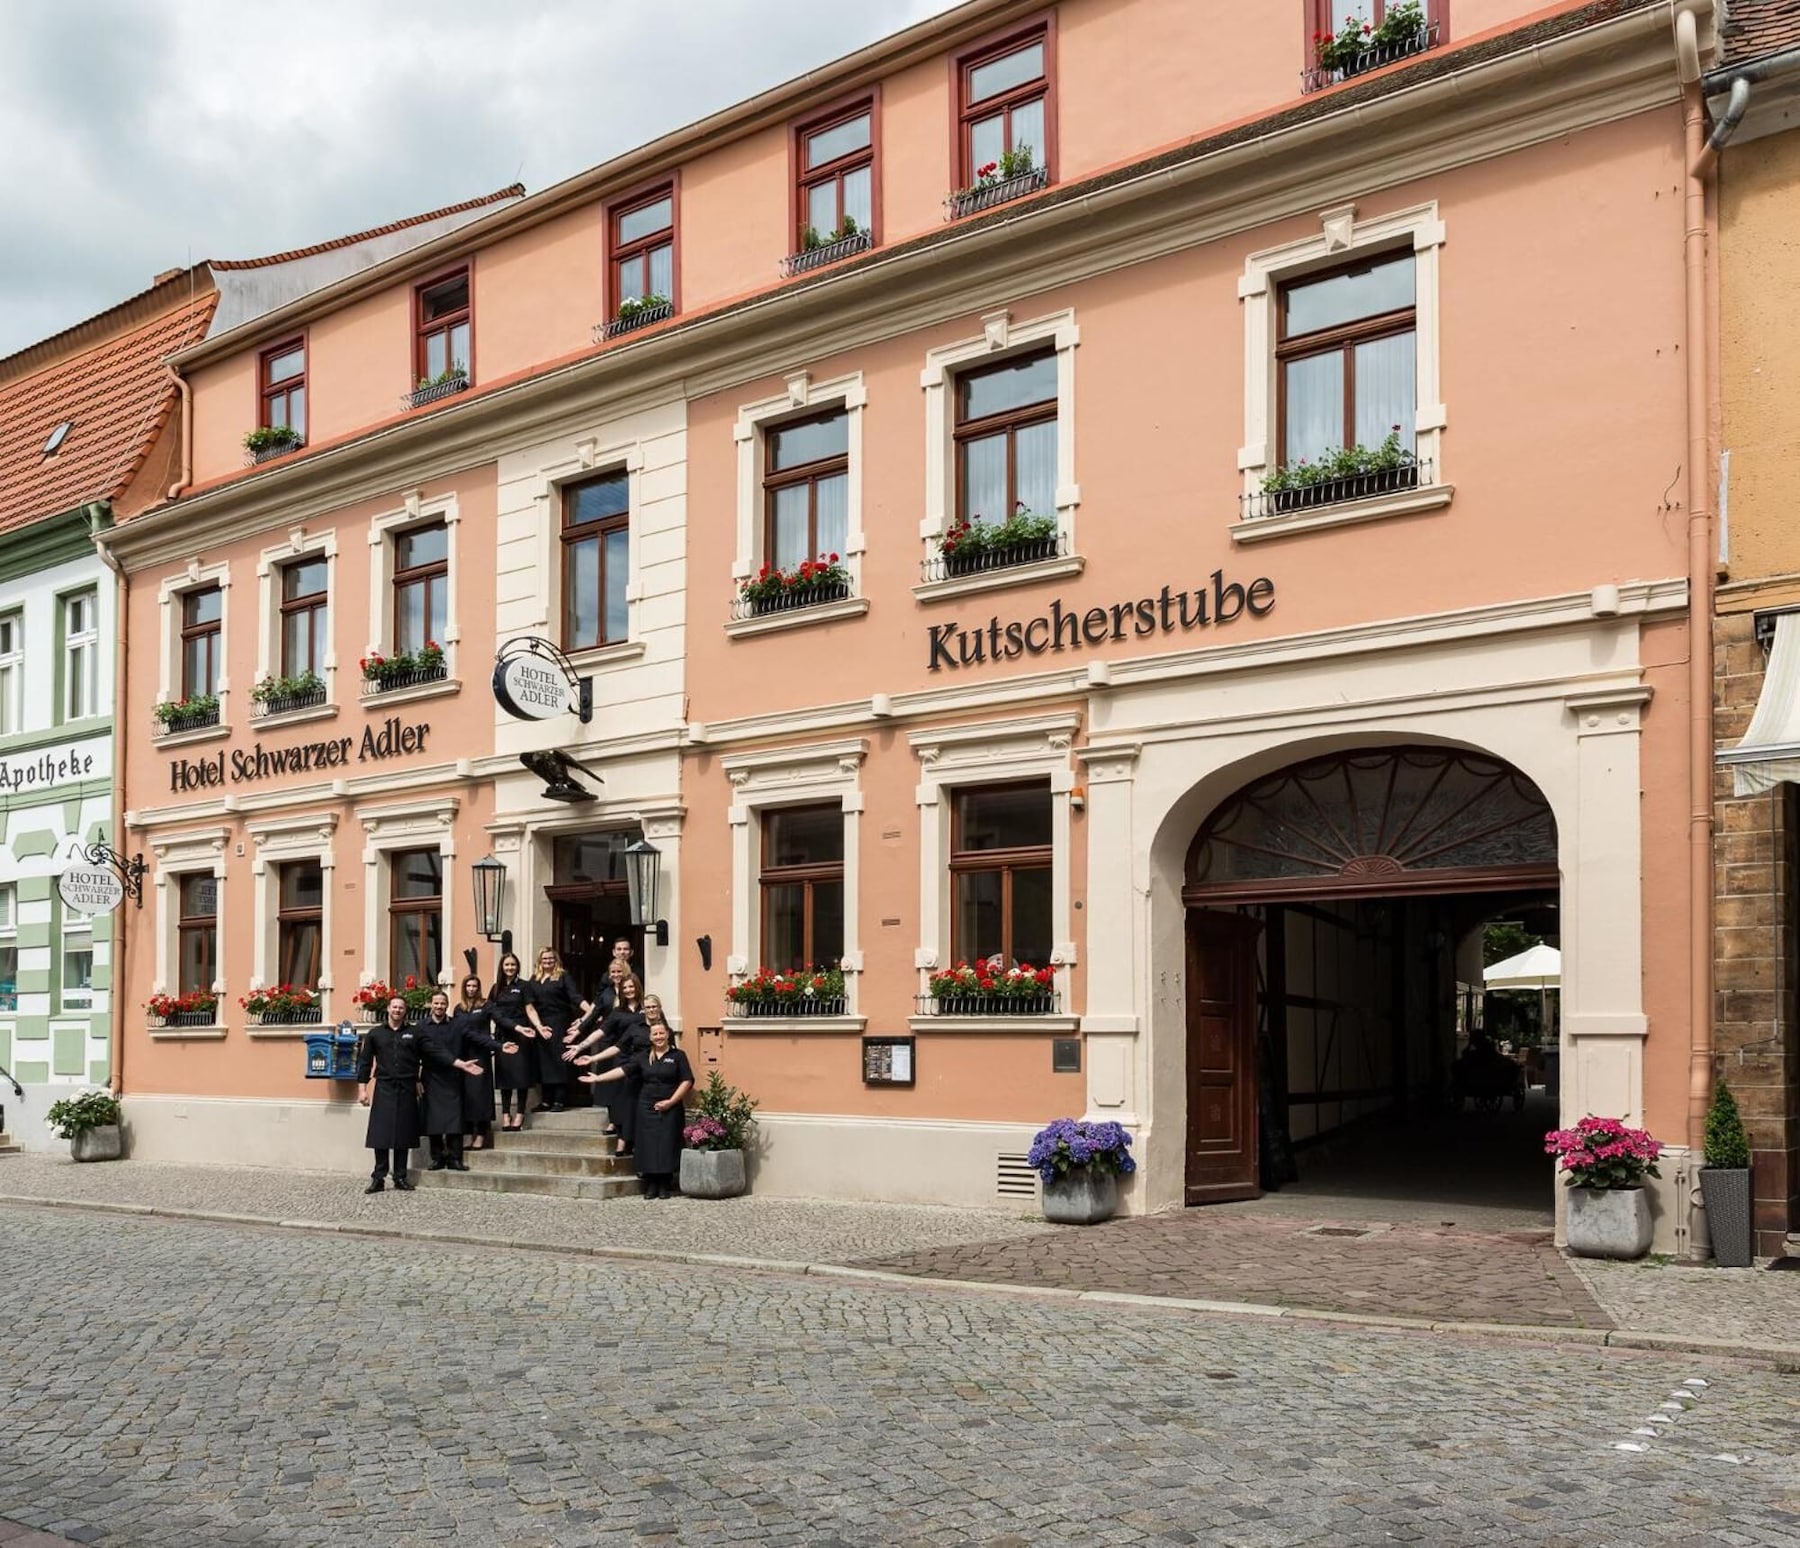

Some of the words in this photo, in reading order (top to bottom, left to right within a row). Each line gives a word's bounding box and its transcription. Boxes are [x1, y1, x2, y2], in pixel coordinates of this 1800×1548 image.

[927, 569, 1275, 670] Kutscherstube
[520, 665, 558, 686] HOTEL
[513, 676, 566, 698] SCHWARZER
[519, 689, 559, 708] ADLER
[170, 750, 224, 791] Hotel
[231, 734, 352, 783] Schwarzer
[358, 716, 430, 763] Adler
[0, 748, 93, 793] Apotheke
[62, 883, 121, 896] SCHWARZER
[70, 872, 114, 886] HOTEL
[72, 893, 111, 905] ADLER
